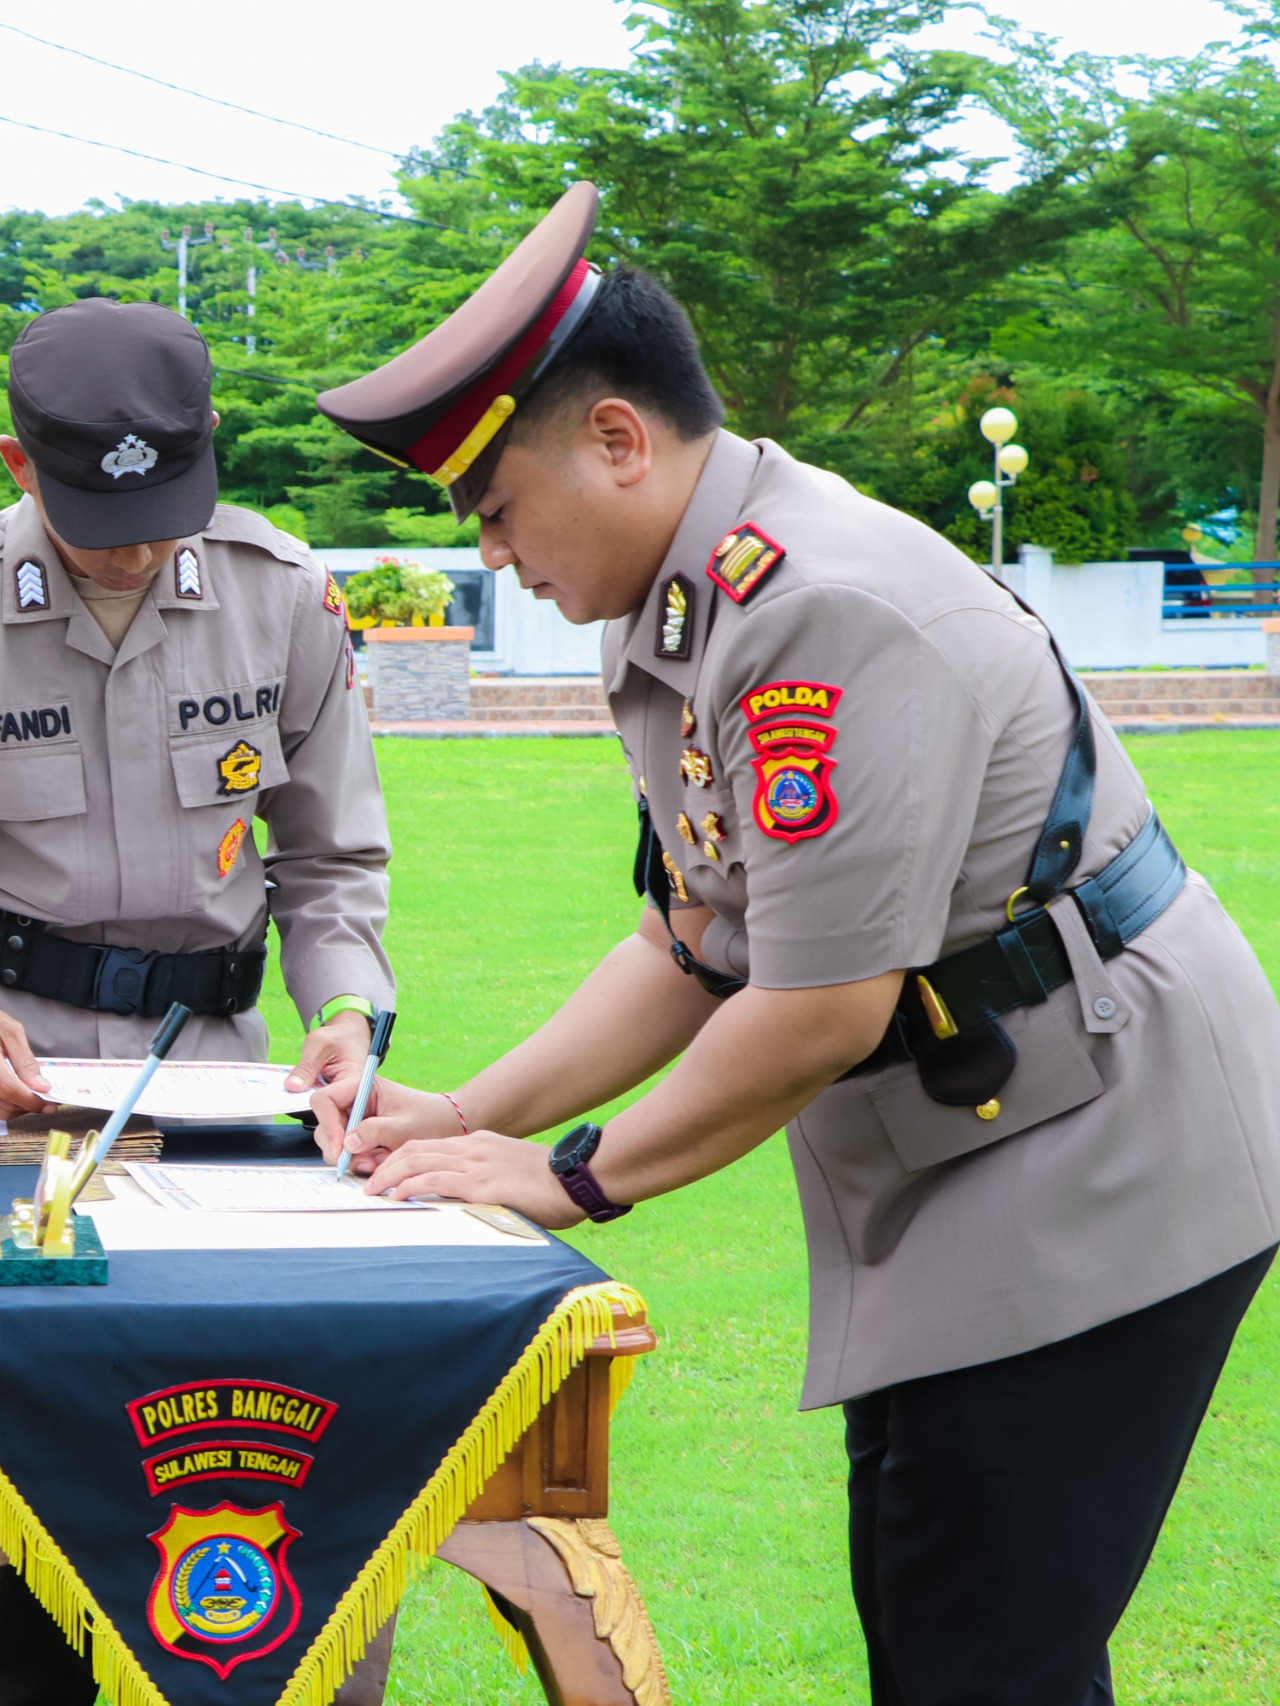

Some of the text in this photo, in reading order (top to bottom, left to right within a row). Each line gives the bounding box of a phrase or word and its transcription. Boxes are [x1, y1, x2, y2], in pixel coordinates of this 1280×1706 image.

[178, 683, 280, 730] POLRI
[749, 687, 828, 715] POLDA
[142, 1389, 321, 1435] POLRES BANGGAI
[154, 1450, 301, 1484] SULAWESI TENGAH
